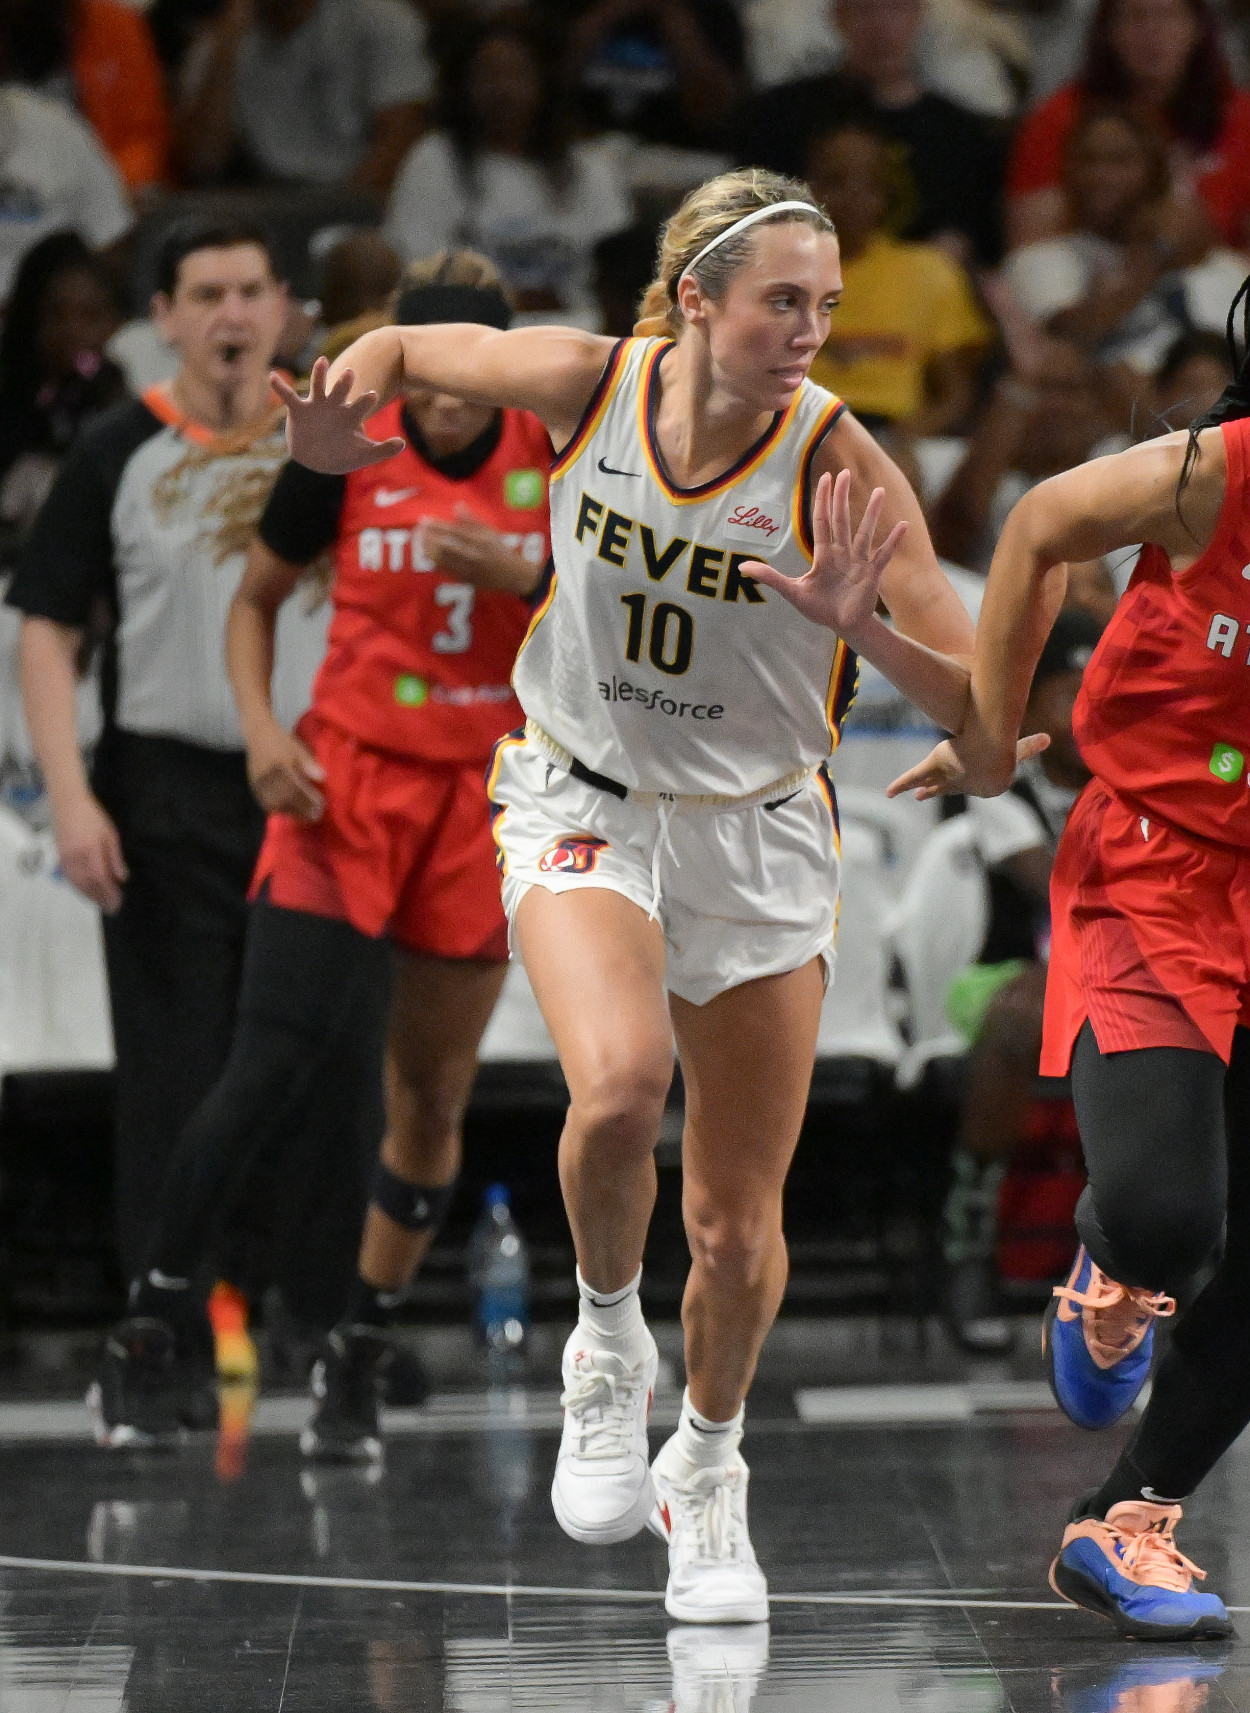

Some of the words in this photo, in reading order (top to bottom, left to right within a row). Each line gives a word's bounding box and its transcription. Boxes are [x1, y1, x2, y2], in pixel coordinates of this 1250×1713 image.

[574, 490, 768, 604] FEVER
[727, 504, 780, 538] Lilly
[432, 582, 475, 654] 3
[620, 592, 694, 677] 10
[597, 675, 725, 720] alesforce
